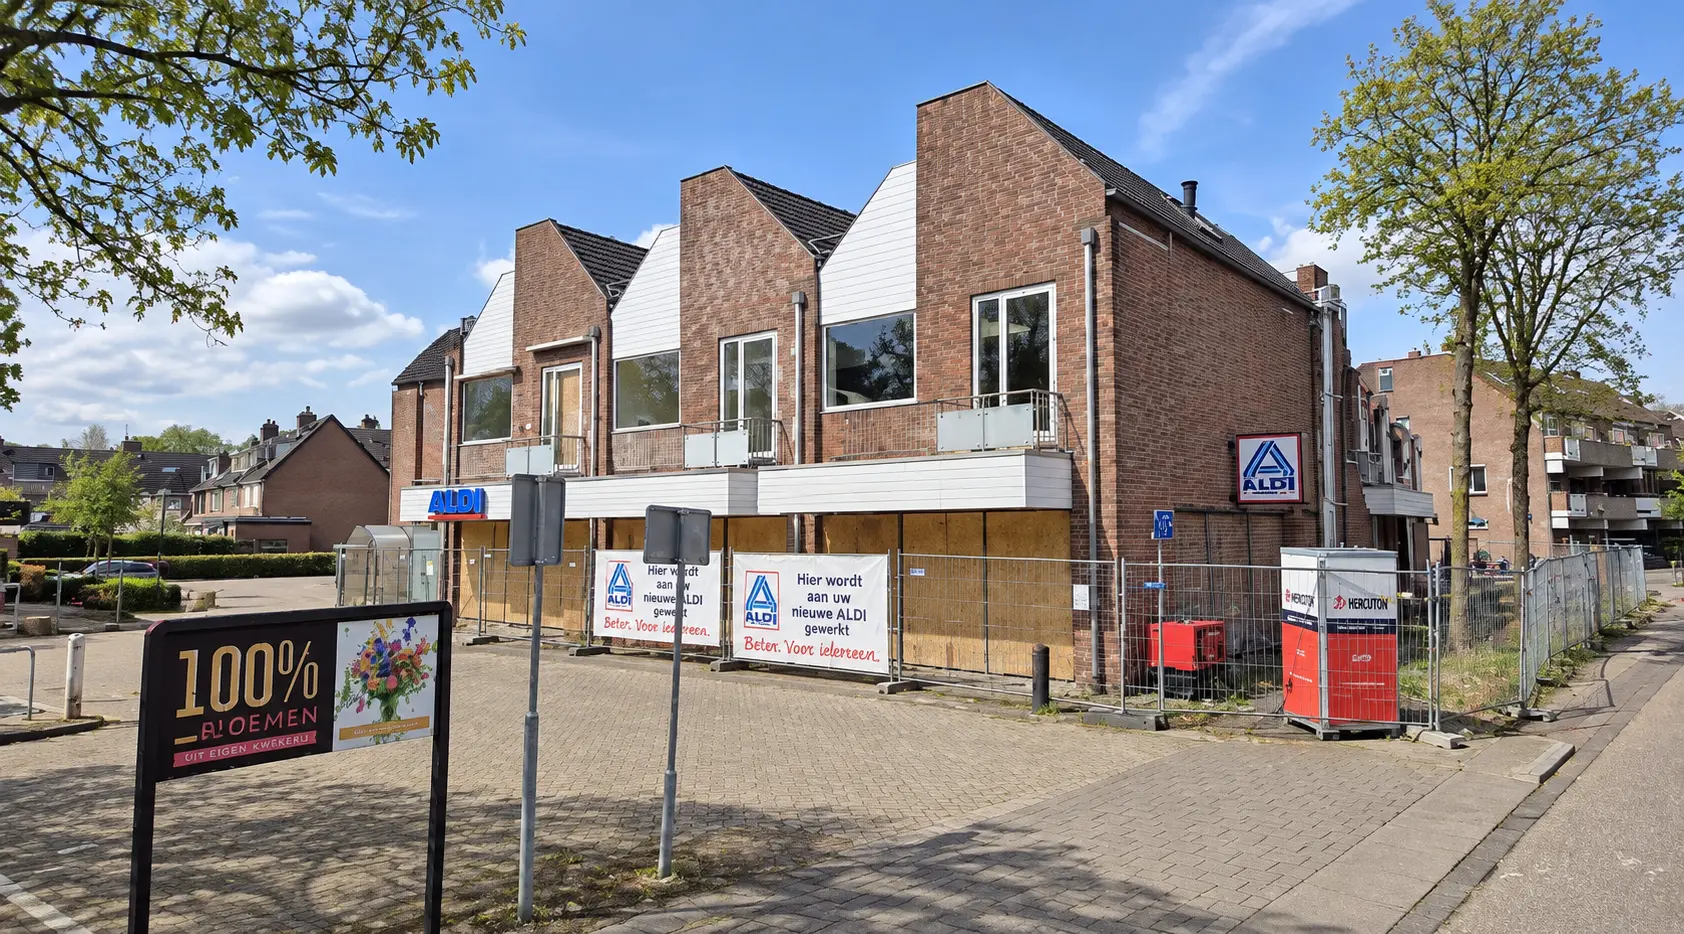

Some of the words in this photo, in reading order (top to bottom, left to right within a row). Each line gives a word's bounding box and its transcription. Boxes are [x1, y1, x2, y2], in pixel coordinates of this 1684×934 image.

[1243, 477, 1295, 491] ALDI
[428, 488, 487, 514] ALDI
[648, 565, 667, 576] Hier
[670, 566, 699, 577] wrdt
[656, 581, 673, 590] aan
[676, 582, 690, 591] w
[797, 573, 822, 586] Hier
[826, 575, 862, 588] wordt
[607, 595, 631, 606] ALDI
[643, 592, 676, 603] nieuwe
[807, 592, 828, 603] aan
[833, 593, 851, 604] uw
[1348, 597, 1388, 610] HERCUTON
[653, 608, 688, 619] gewet
[746, 612, 777, 626] ALDI
[792, 606, 833, 619] nieuwe
[836, 608, 867, 622] ALDI
[804, 623, 850, 637] gewerkt
[744, 636, 781, 653] Beter.
[784, 640, 814, 656] Voor
[175, 639, 319, 718] 100%
[184, 750, 205, 763] UIT
[209, 744, 248, 759] EIGEN
